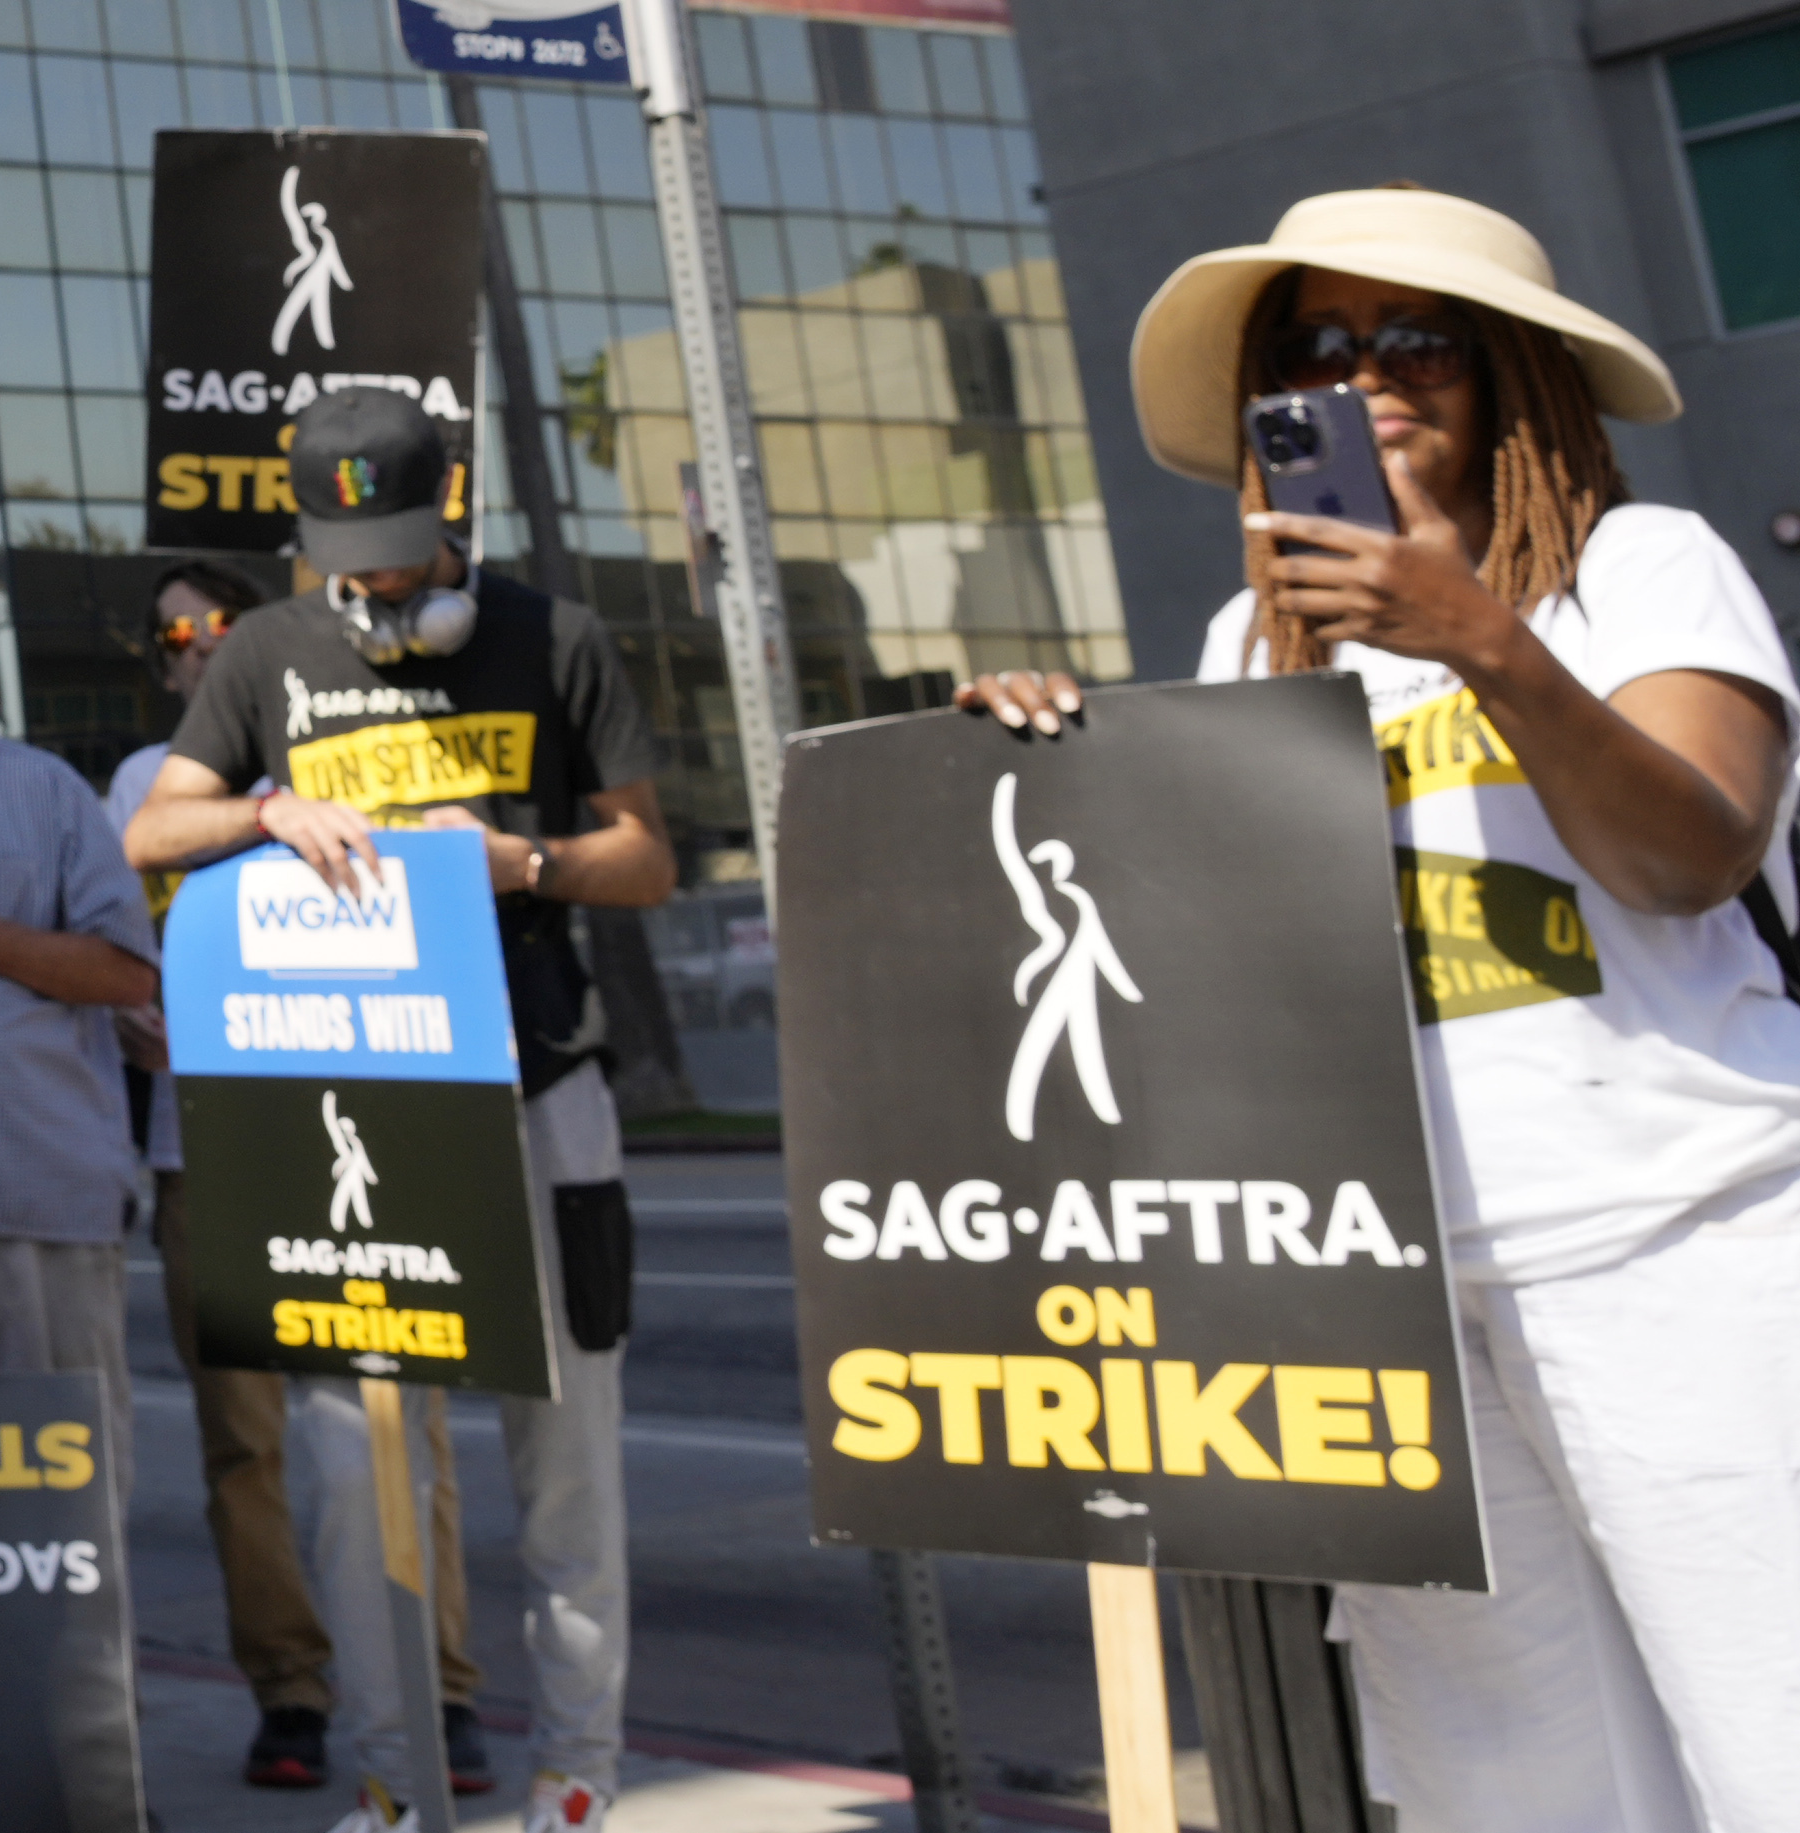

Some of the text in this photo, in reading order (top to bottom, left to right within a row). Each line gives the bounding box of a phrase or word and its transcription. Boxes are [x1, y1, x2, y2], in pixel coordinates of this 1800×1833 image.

[158, 454, 466, 520] STR!
[310, 727, 515, 799] ON STRIKE
[249, 895, 396, 930] WGAW
[223, 993, 453, 1054] STANDS WITH
[342, 1279, 387, 1307] ON
[1036, 1285, 1157, 1348] ON
[272, 1299, 468, 1359] STRIKE!
[827, 1347, 1441, 1492] STRIKE!
